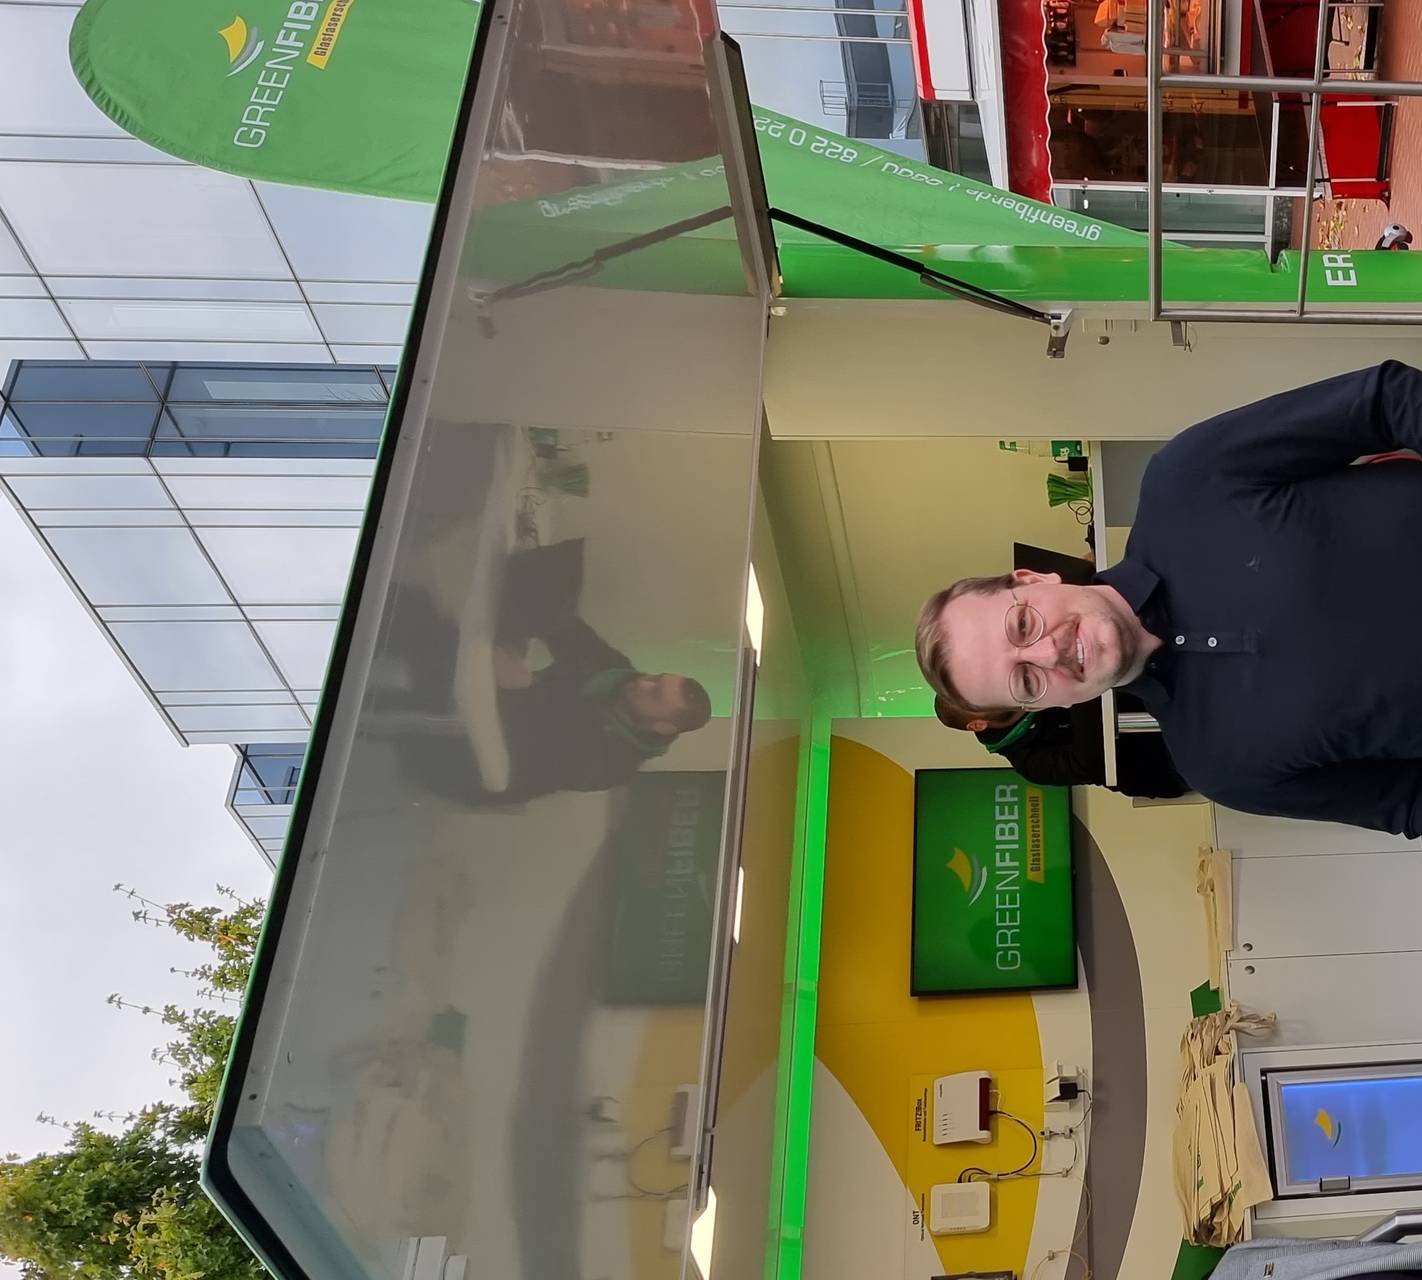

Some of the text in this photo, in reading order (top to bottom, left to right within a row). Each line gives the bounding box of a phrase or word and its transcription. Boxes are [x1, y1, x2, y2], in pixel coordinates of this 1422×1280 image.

[232, 0, 324, 148] GREENFIB
[751, 114, 786, 138] 22
[787, 127, 807, 146] 0
[809, 135, 858, 162] 822
[1322, 249, 1357, 286] ER
[994, 784, 1021, 971] GREENFIBER
[912, 1210, 920, 1225] ONT
